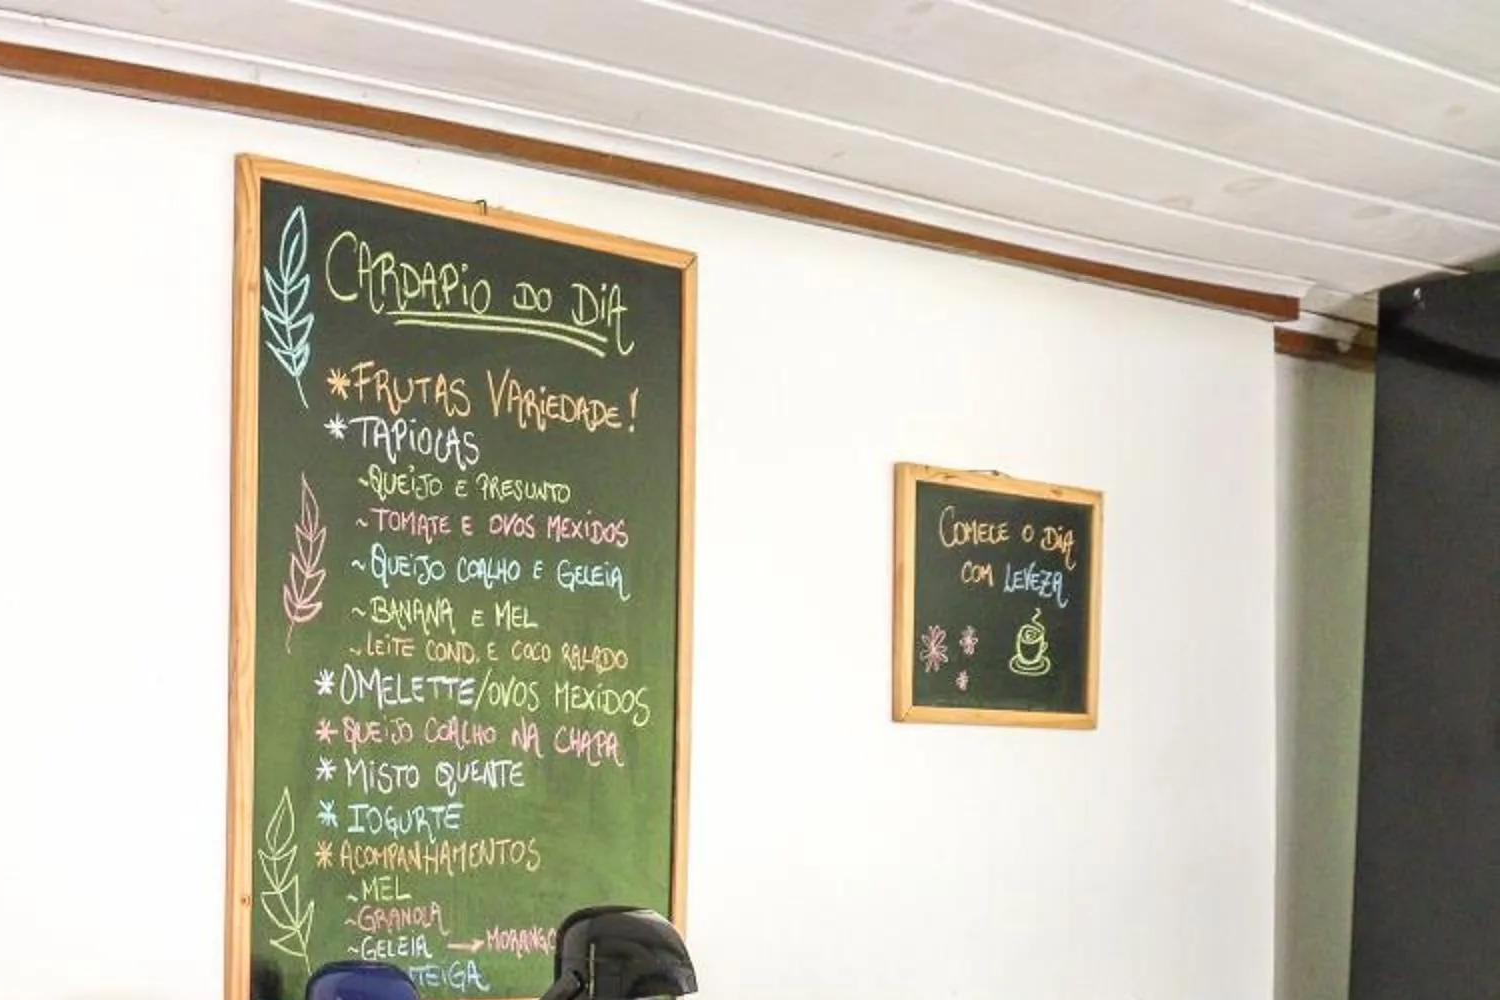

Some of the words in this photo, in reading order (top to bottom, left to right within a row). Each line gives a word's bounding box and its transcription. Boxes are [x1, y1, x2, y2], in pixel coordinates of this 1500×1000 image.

[514, 282, 552, 312] DO
[572, 281, 634, 356] DIA
[456, 480, 467, 497] E
[477, 473, 571, 502] PRESUNTO
[370, 508, 451, 544] TOMATE
[462, 518, 473, 536] E
[490, 514, 535, 537] OVOS
[547, 510, 629, 547] MEXIDOS
[939, 506, 1010, 547] COMECE
[1022, 525, 1034, 542] O
[1041, 527, 1076, 570] DIA
[458, 555, 520, 588] COALHO
[534, 560, 543, 579] E
[558, 560, 629, 601] GELEIA
[961, 560, 993, 587] COM
[1003, 561, 1068, 608] LEVEZA
[371, 598, 455, 635] BANANA
[472, 609, 484, 628] E
[496, 601, 538, 630] MEL
[367, 634, 415, 657] LEITE
[488, 644, 497, 660] E
[511, 641, 550, 663] COCO
[561, 644, 628, 673] RALADO
[556, 680, 650, 727] MEXIDOS
[425, 718, 496, 751] COALHO
[512, 718, 543, 758] NA
[555, 727, 624, 766] CHAPA
[346, 759, 420, 795] MISTO
[436, 759, 525, 796] QUENTE
[347, 802, 464, 844] IOGURTE
[340, 838, 541, 877] ACOMPANHAMENTOS
[361, 876, 411, 901] MEL
[358, 902, 448, 935] GRANOLA
[361, 931, 432, 960] GELEIA
